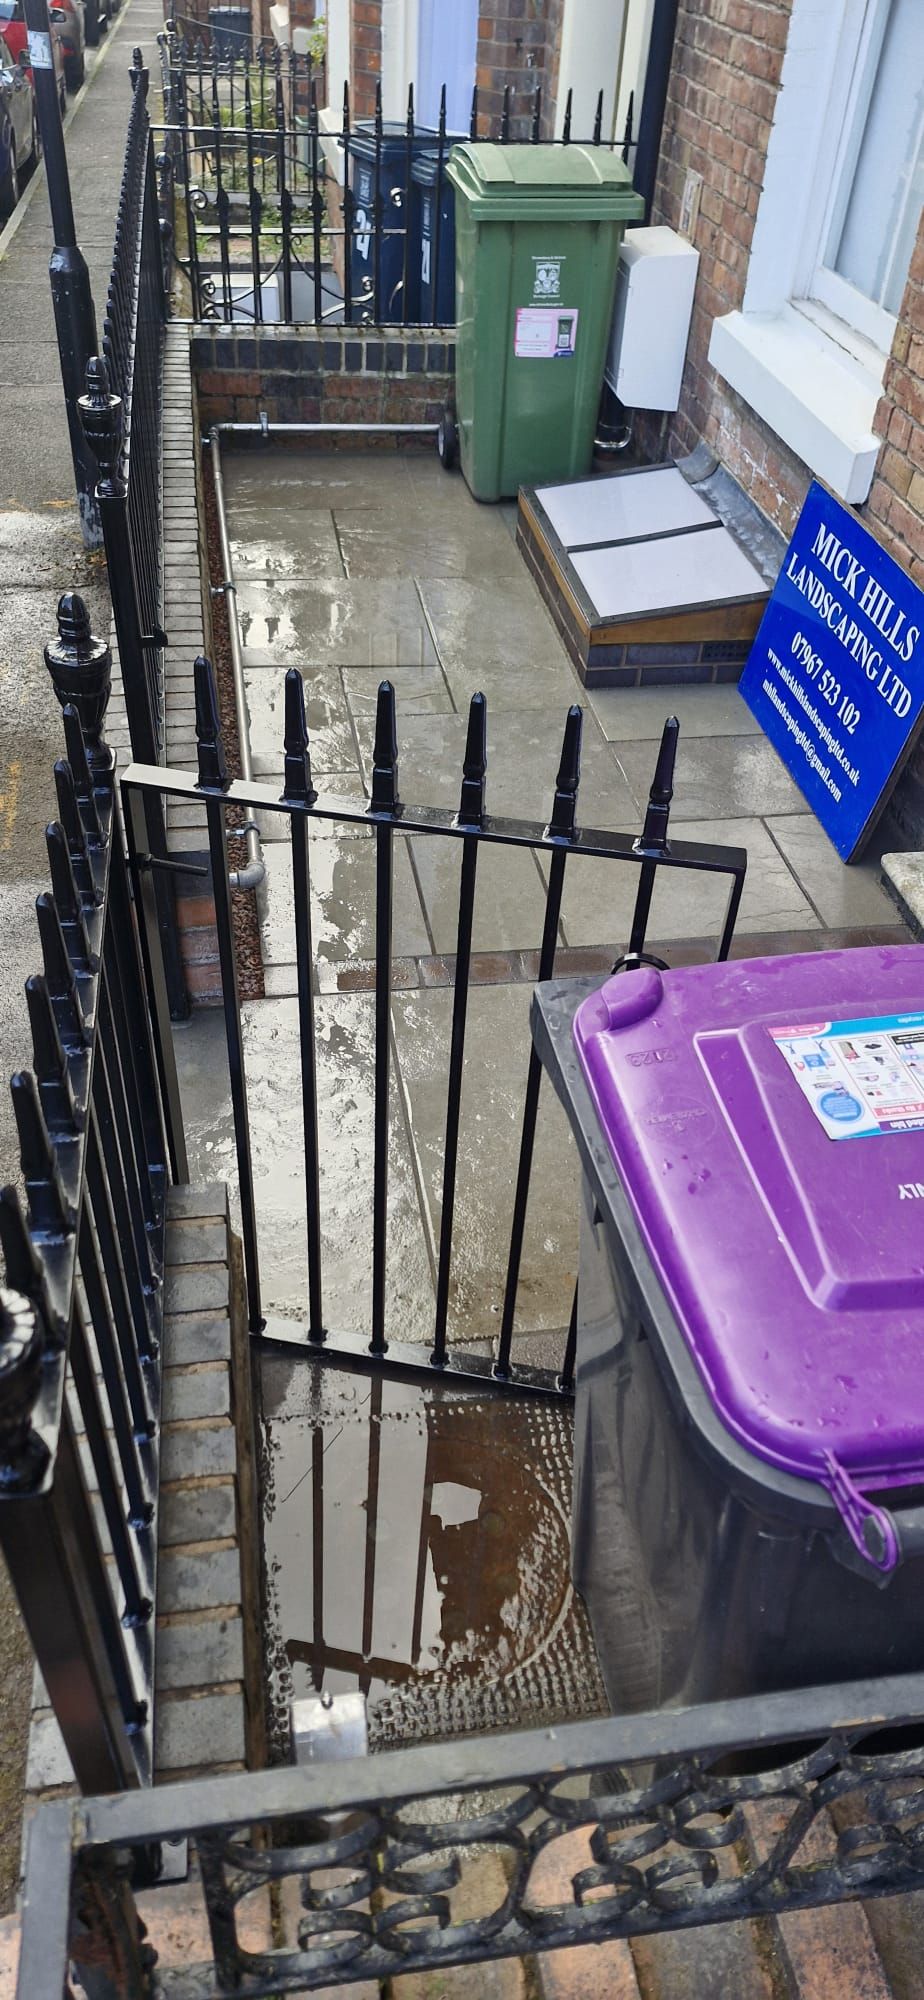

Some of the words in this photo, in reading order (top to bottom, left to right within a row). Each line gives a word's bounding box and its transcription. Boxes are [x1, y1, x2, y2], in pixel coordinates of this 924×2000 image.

[786, 552, 883, 681] LANDSCAPING
[877, 664, 912, 718] LTD
[811, 522, 866, 600] MICK
[858, 575, 920, 661] HILLS
[767, 648, 860, 787] www.mickhillslandscapingltd.co.uk
[791, 631, 824, 681] 07967
[818, 669, 841, 706] 523
[837, 696, 861, 735] 102
